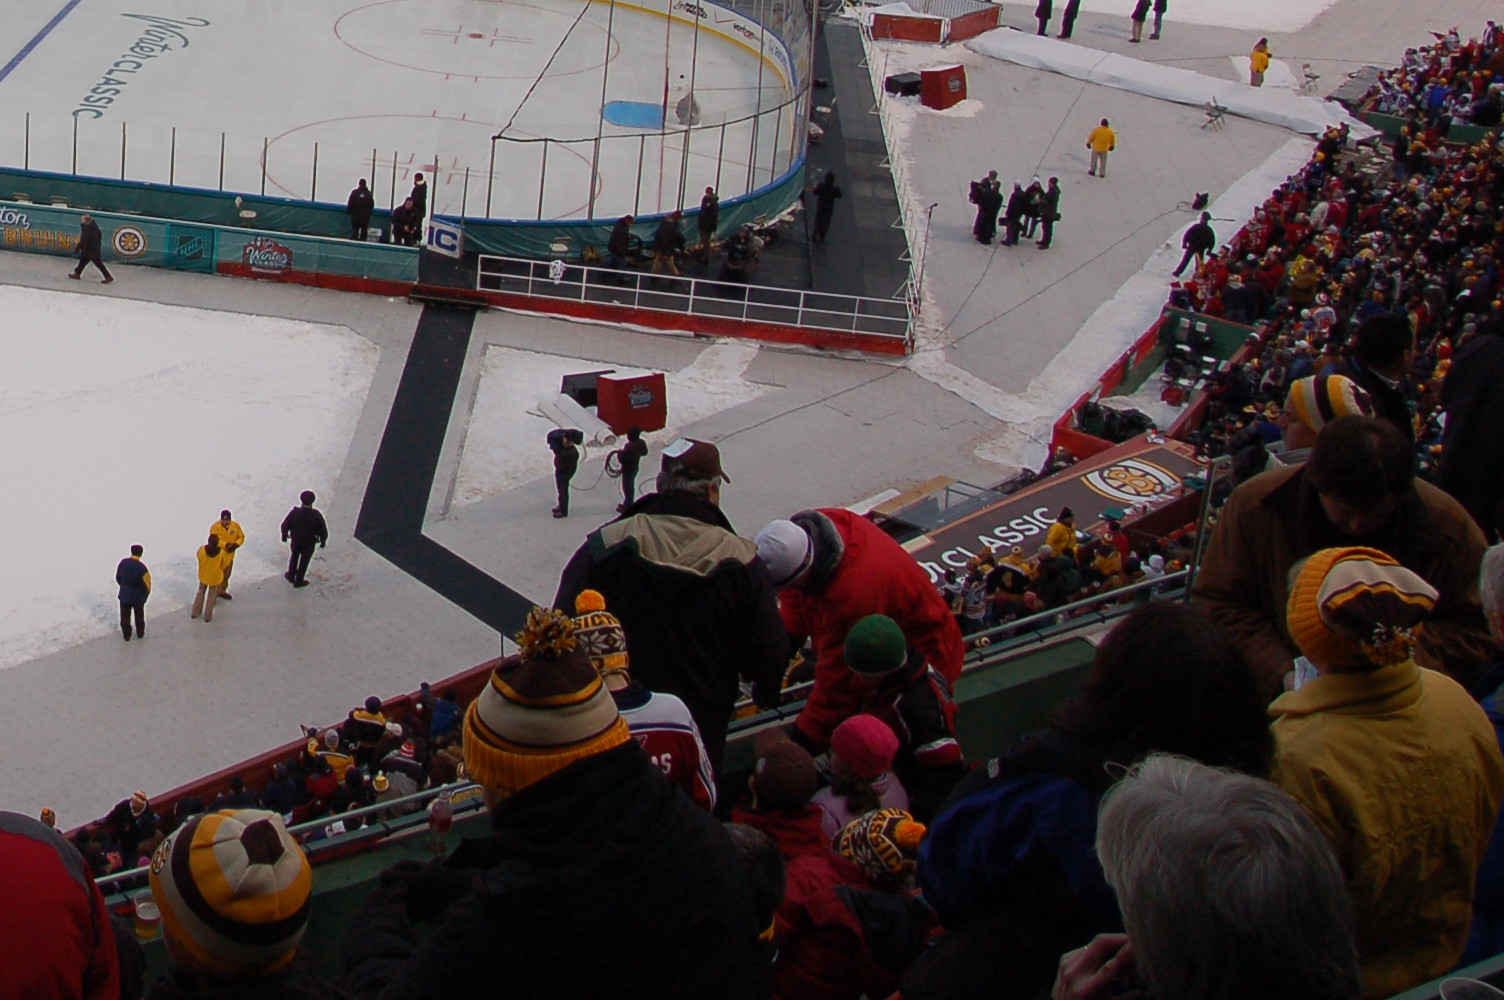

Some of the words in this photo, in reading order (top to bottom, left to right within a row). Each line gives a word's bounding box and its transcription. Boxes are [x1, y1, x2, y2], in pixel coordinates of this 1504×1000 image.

[120, 12, 210, 61] Winter
[72, 59, 144, 119] CLASSIC
[3, 226, 81, 251] BRUIN
[246, 246, 288, 265] Winter
[941, 506, 1060, 569] CLASSIC
